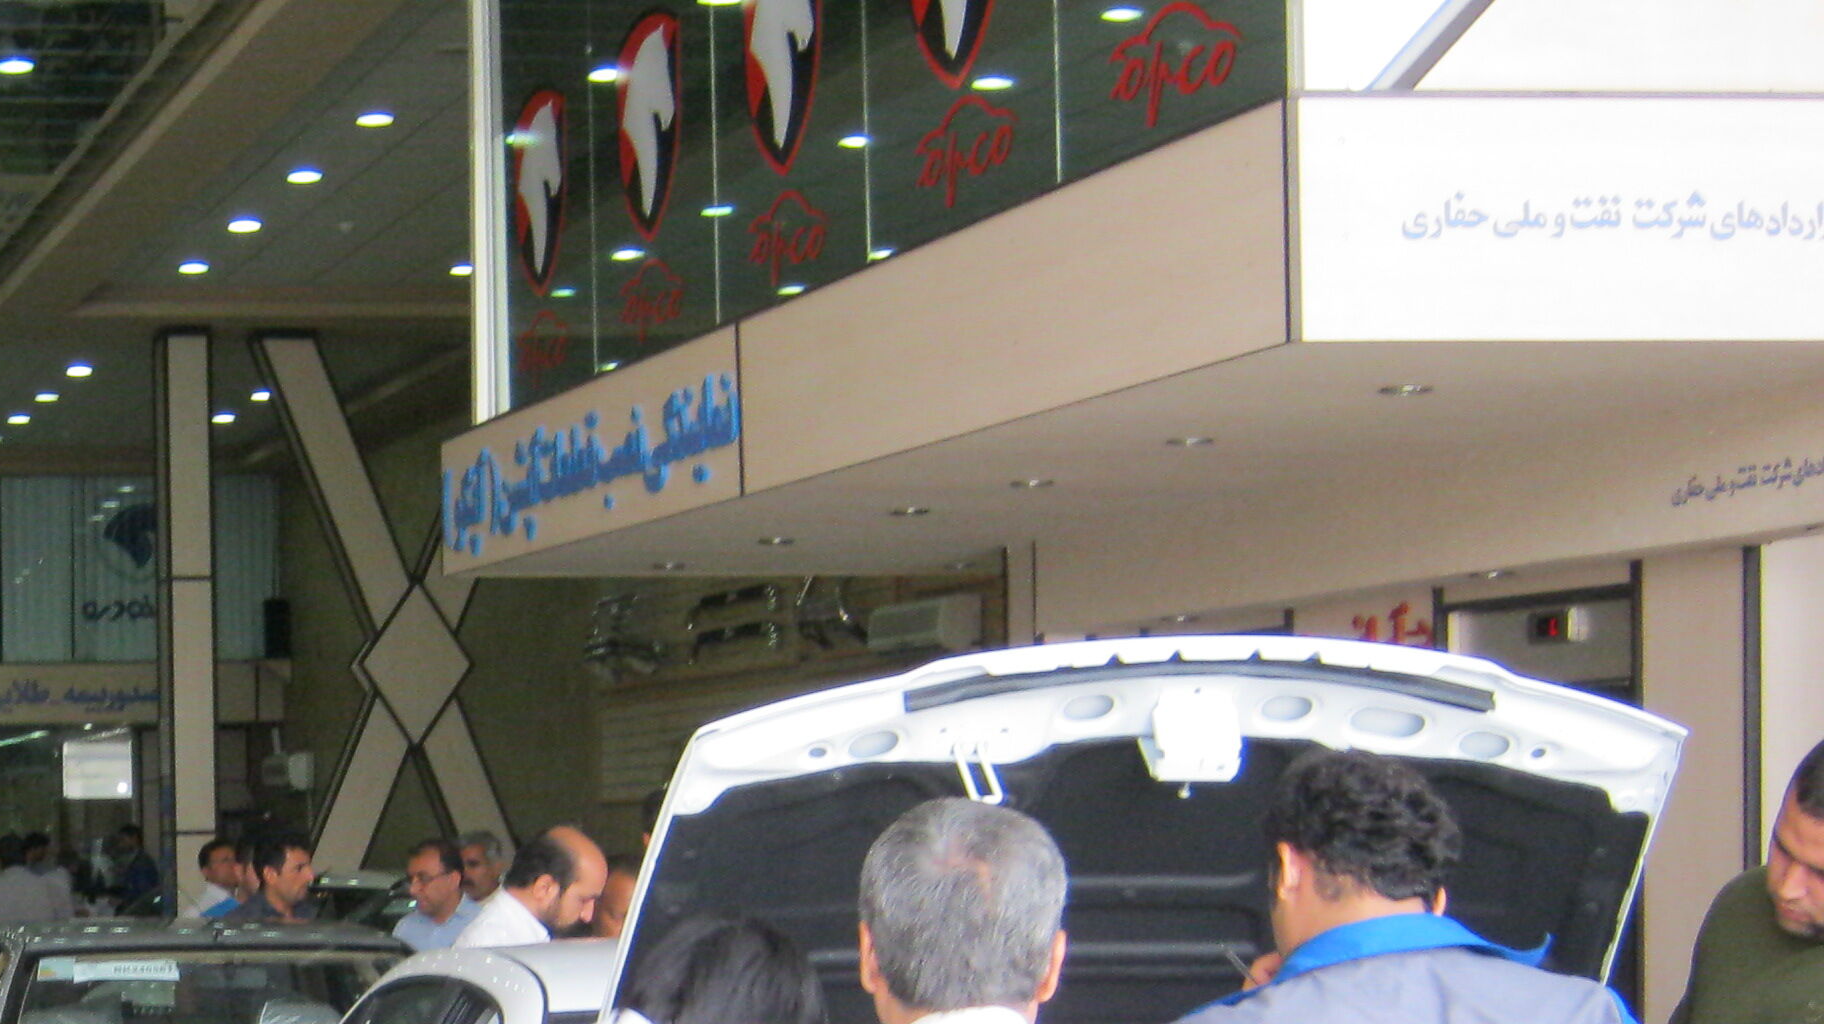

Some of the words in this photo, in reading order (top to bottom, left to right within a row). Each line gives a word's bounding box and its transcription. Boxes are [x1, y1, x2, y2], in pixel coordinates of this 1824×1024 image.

[1401, 190, 1489, 240] حفاری
[1492, 200, 1547, 239] ملی
[1549, 209, 1567, 239] و
[1570, 194, 1622, 230] نفت
[1632, 190, 1707, 240] شرکت
[1709, 200, 1824, 241] اردادهای
